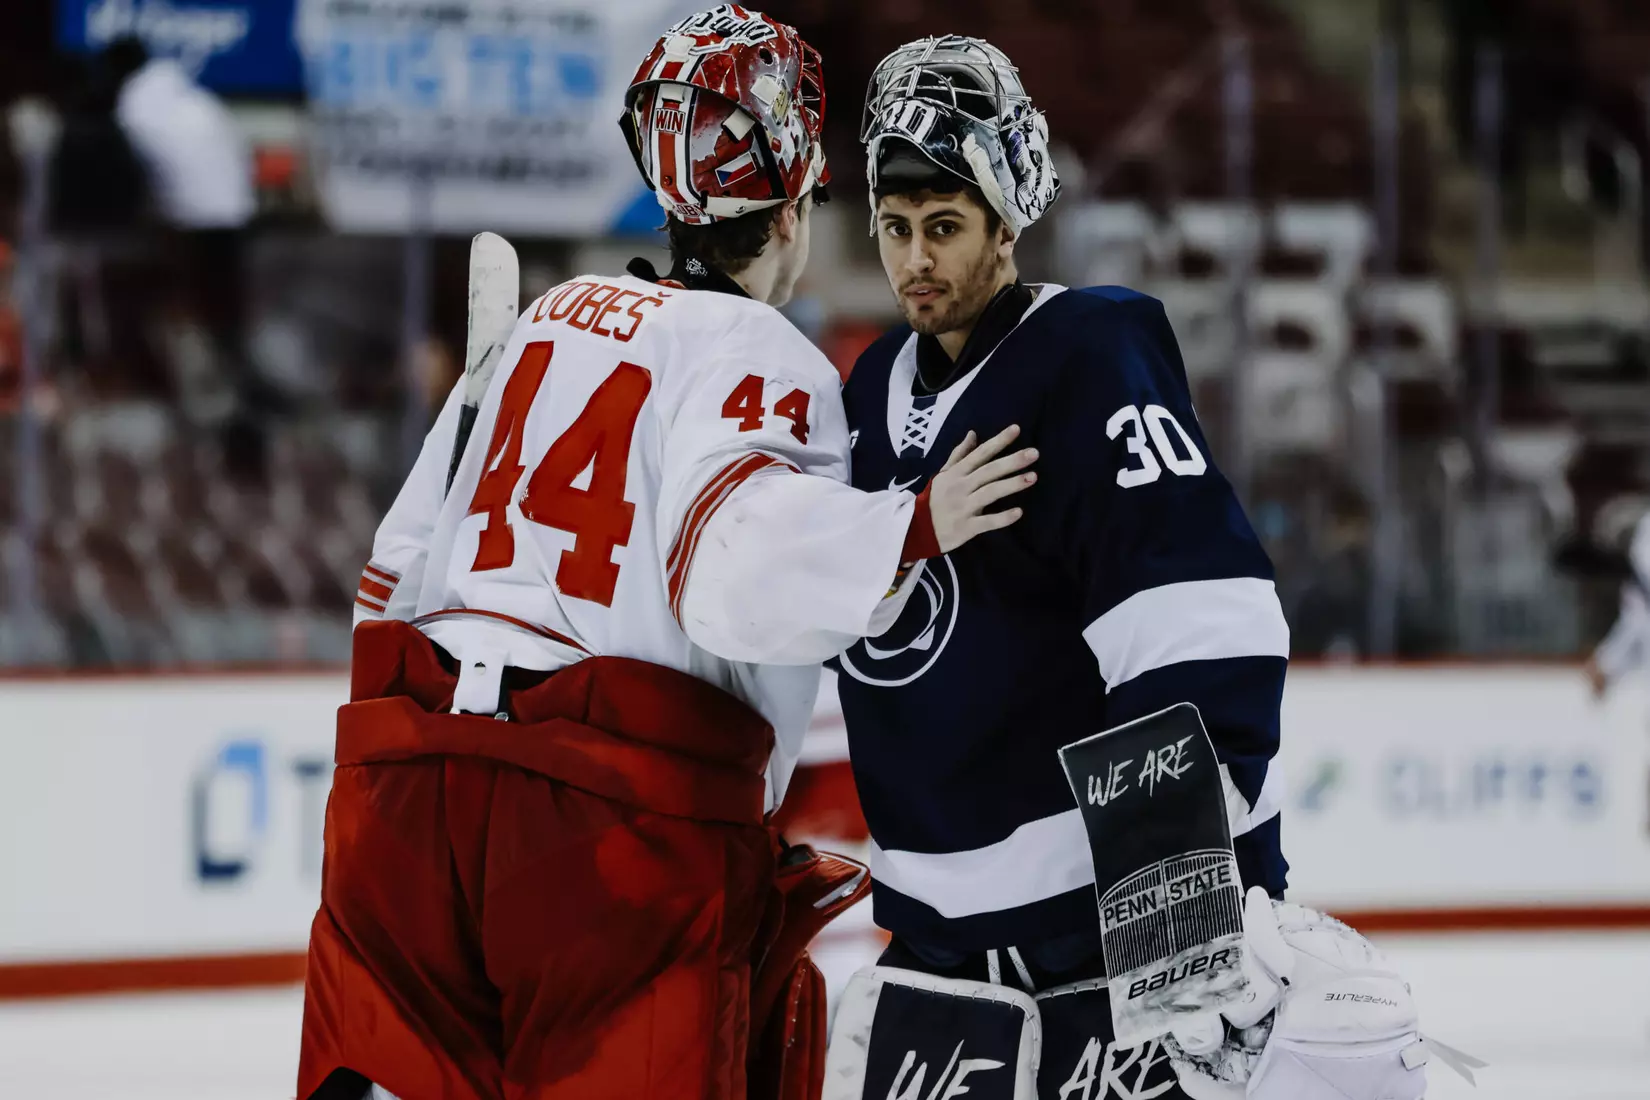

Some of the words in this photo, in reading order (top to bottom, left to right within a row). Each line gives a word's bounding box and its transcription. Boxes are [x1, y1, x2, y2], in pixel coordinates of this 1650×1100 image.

[655, 108, 685, 134] WIN
[531, 281, 673, 343] DOBEŠ
[720, 373, 812, 446] 44
[468, 339, 653, 608] 44
[1105, 404, 1208, 489] 30
[1087, 758, 1134, 807] WE
[1138, 733, 1196, 797] ARE
[1103, 889, 1158, 929] PENN
[1170, 863, 1232, 902] STATE
[1127, 948, 1231, 1001] BAUER
[1324, 992, 1398, 1007] HYPERLITE
